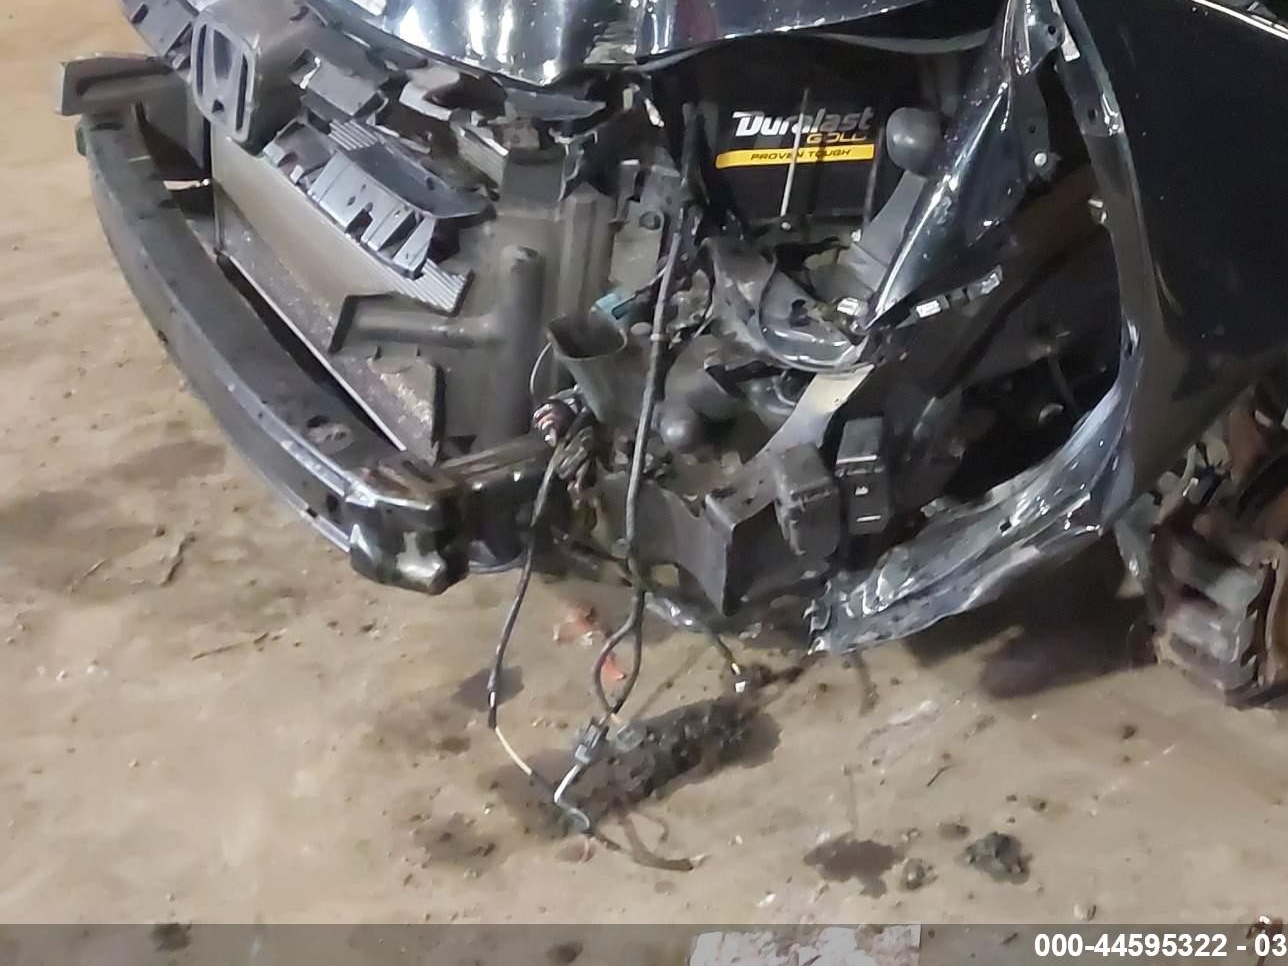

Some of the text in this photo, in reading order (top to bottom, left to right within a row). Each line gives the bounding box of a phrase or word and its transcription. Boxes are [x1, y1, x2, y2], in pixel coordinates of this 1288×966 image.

[732, 106, 874, 137] Duralast
[750, 149, 851, 161] PROVEN TOUGH
